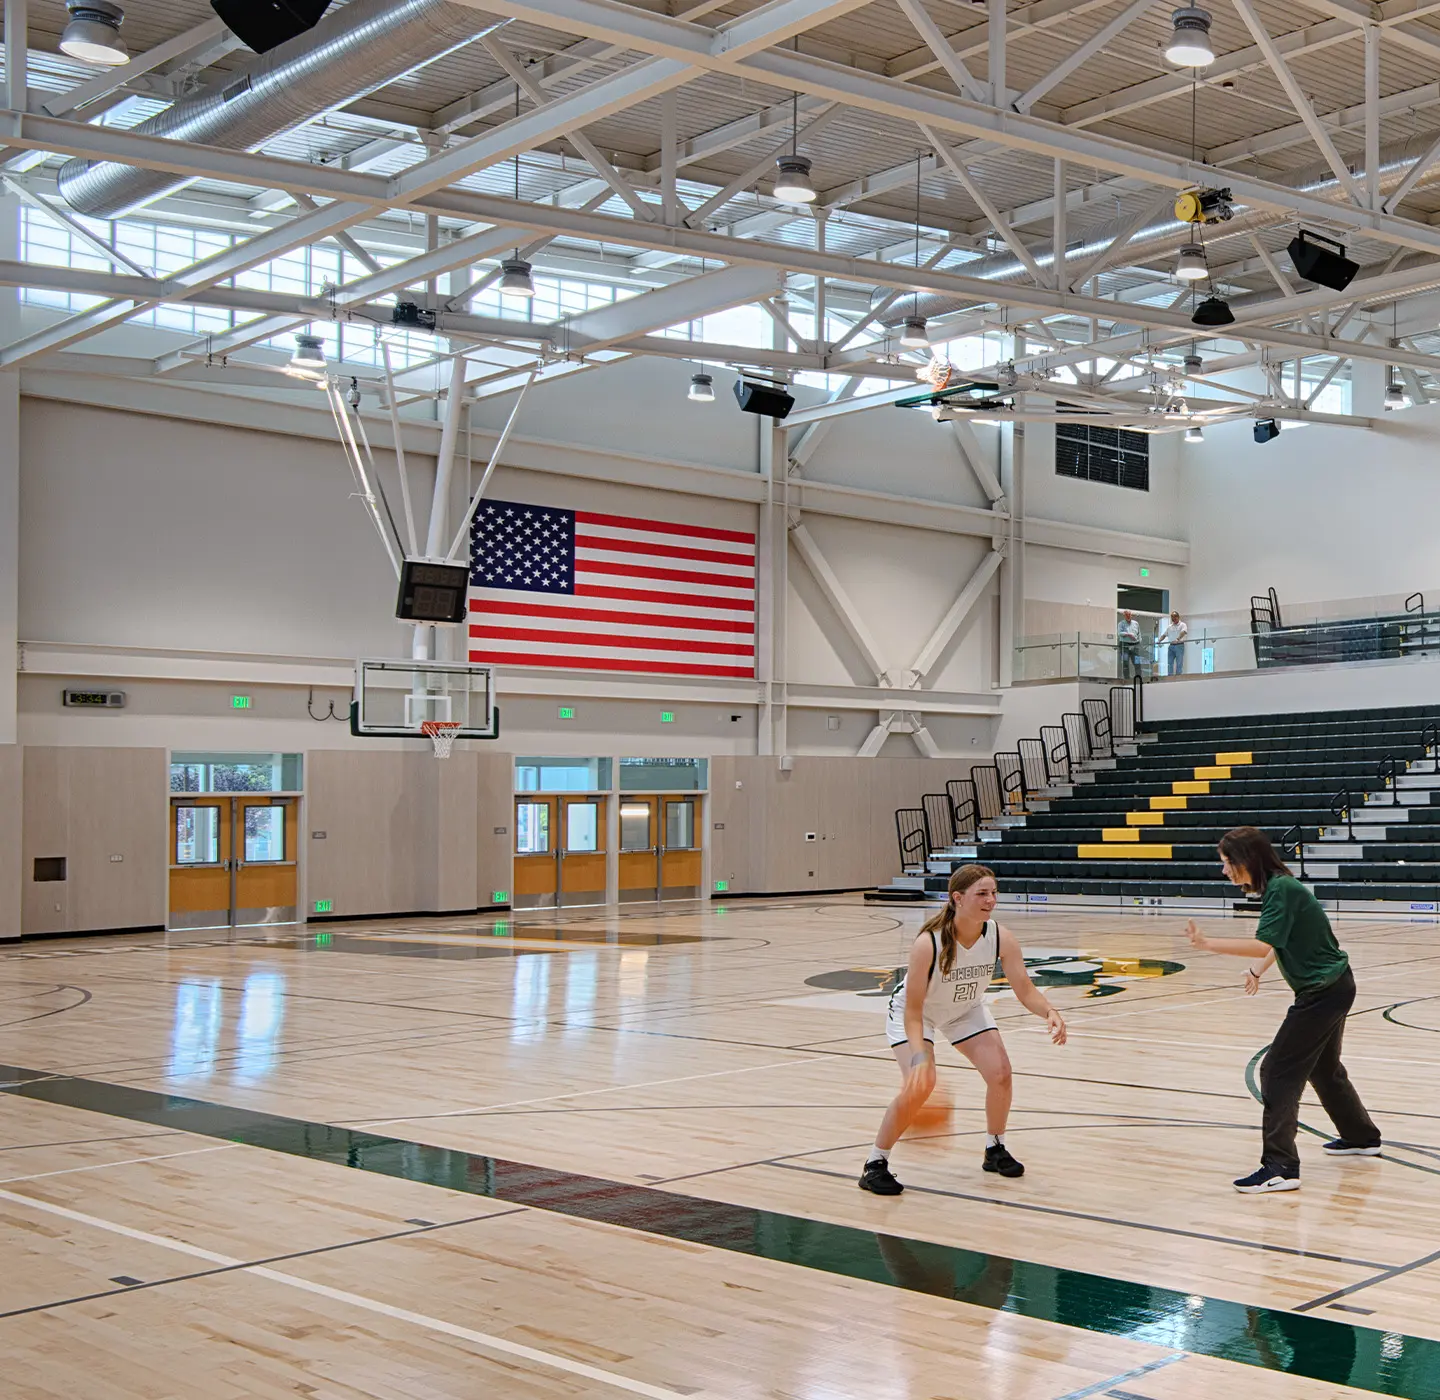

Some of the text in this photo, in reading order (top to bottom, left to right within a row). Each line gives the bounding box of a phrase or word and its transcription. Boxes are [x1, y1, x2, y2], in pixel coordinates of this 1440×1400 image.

[233, 696, 249, 708] EXIT
[316, 900, 332, 912] EXIT
[953, 982, 978, 1003] 21
